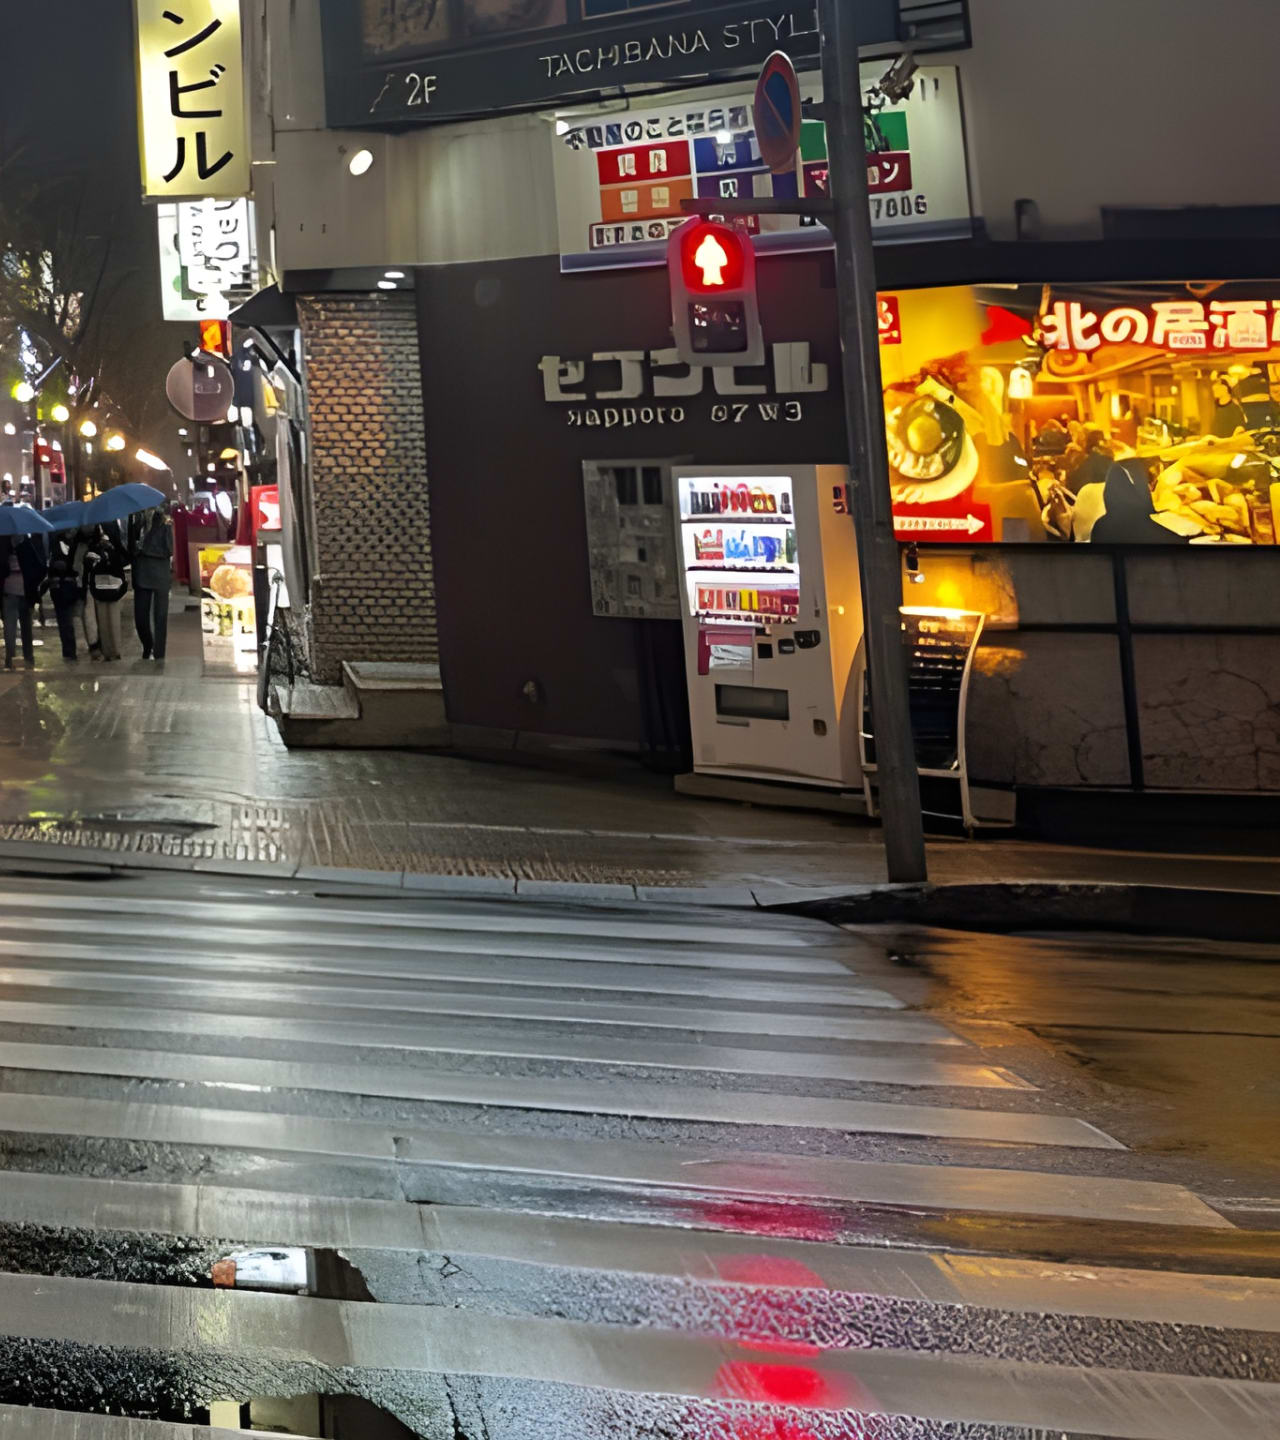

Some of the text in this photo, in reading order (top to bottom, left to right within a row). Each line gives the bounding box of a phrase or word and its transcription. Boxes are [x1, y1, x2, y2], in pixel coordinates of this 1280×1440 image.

[723, 7, 821, 50] STYL
[404, 72, 438, 107] 2F
[1040, 300, 1280, 351] 北の居酒
